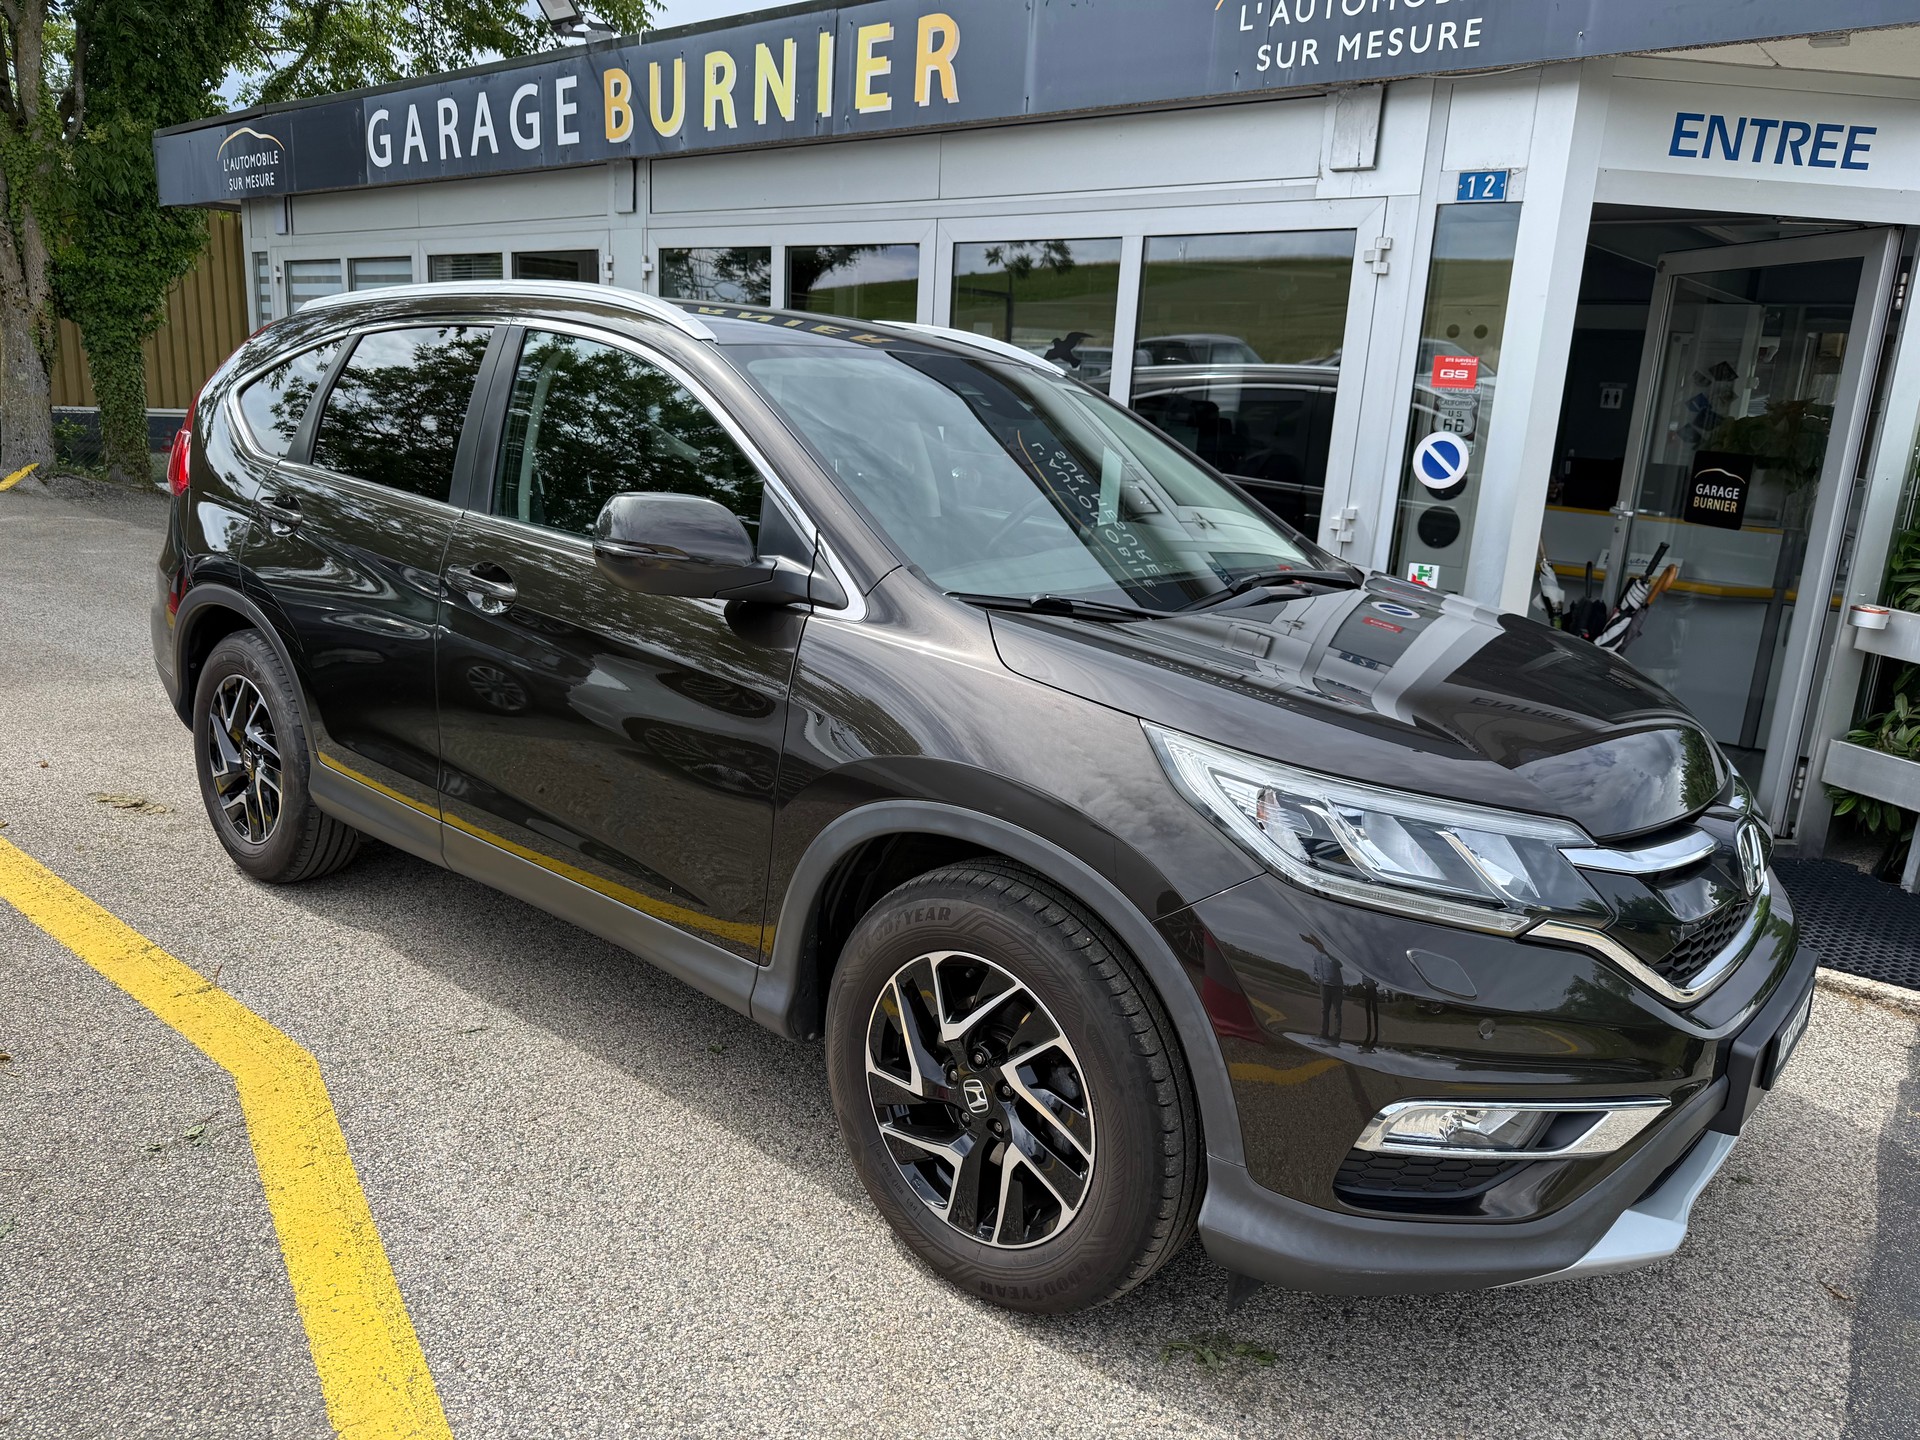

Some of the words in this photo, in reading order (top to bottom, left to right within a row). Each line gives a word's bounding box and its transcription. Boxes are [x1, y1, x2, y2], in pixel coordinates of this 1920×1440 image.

[1239, 0, 1463, 32] L'AUTO
[1256, 38, 1319, 72] SUR
[1337, 17, 1483, 63] MESURE
[367, 75, 580, 168] GARAGE
[603, 13, 960, 143] BURNIER
[1668, 112, 1877, 170] ENTREE
[223, 150, 279, 172] L'AUTOMOBILE
[229, 177, 243, 191] SUR
[245, 172, 275, 189] MESURE
[1467, 174, 1496, 198] 12
[1440, 368, 1469, 379] GS
[1443, 418, 1465, 432] 66
[1695, 483, 1740, 500] GARAGE
[1693, 496, 1738, 513] BURNIER
